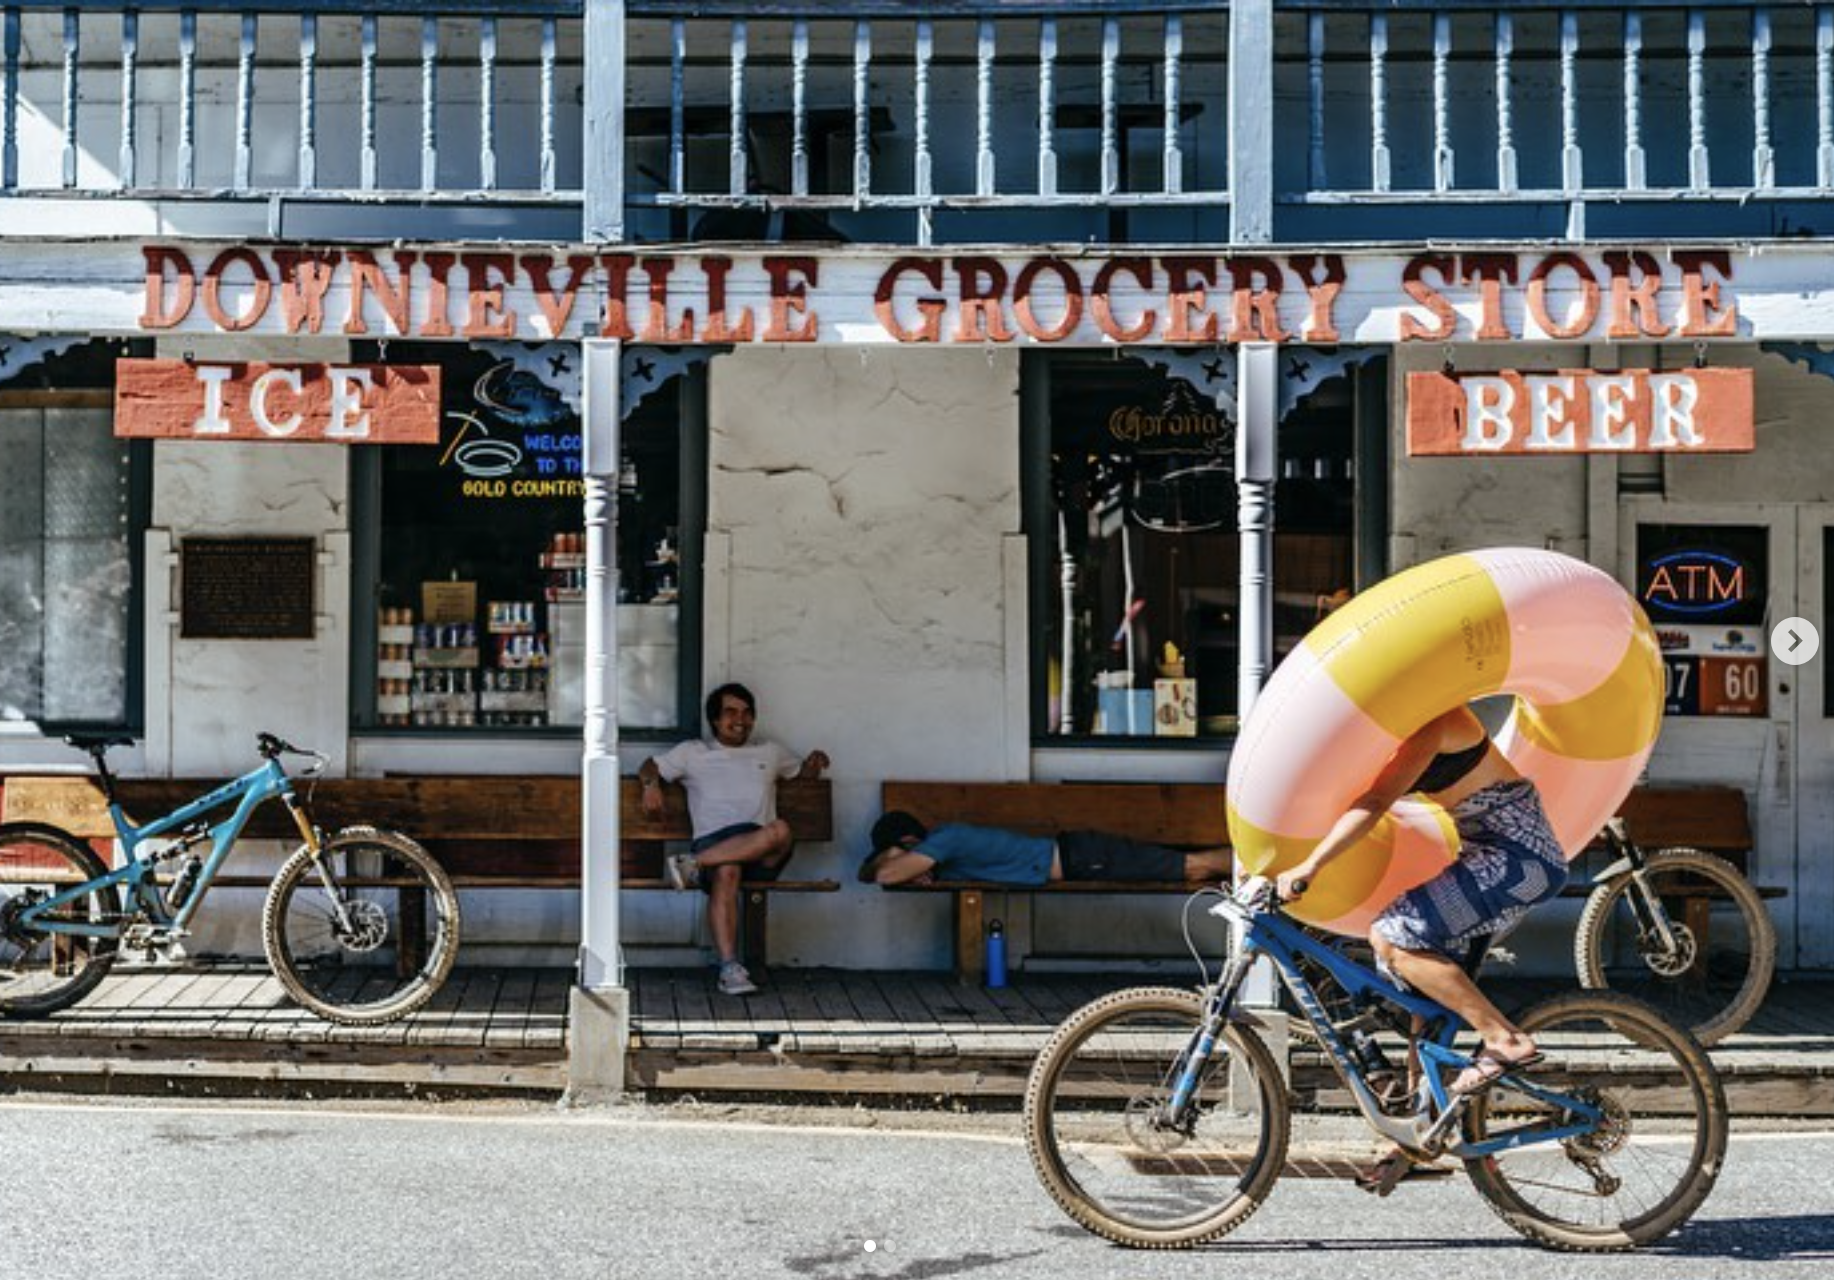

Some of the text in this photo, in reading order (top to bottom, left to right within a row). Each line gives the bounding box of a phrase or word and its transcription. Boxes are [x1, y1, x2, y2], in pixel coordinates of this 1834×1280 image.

[138, 246, 1737, 343] DOWNIEVILLE GROCERY STORE
[194, 366, 371, 437] ICE
[1460, 373, 1704, 450] BEER
[1109, 405, 1217, 441] Corona
[524, 434, 583, 450] WELCO
[536, 458, 581, 473] TO TH
[463, 480, 586, 497] GOLD COUNTRY
[1645, 565, 1743, 601] ATM
[1725, 663, 1759, 700] 60
